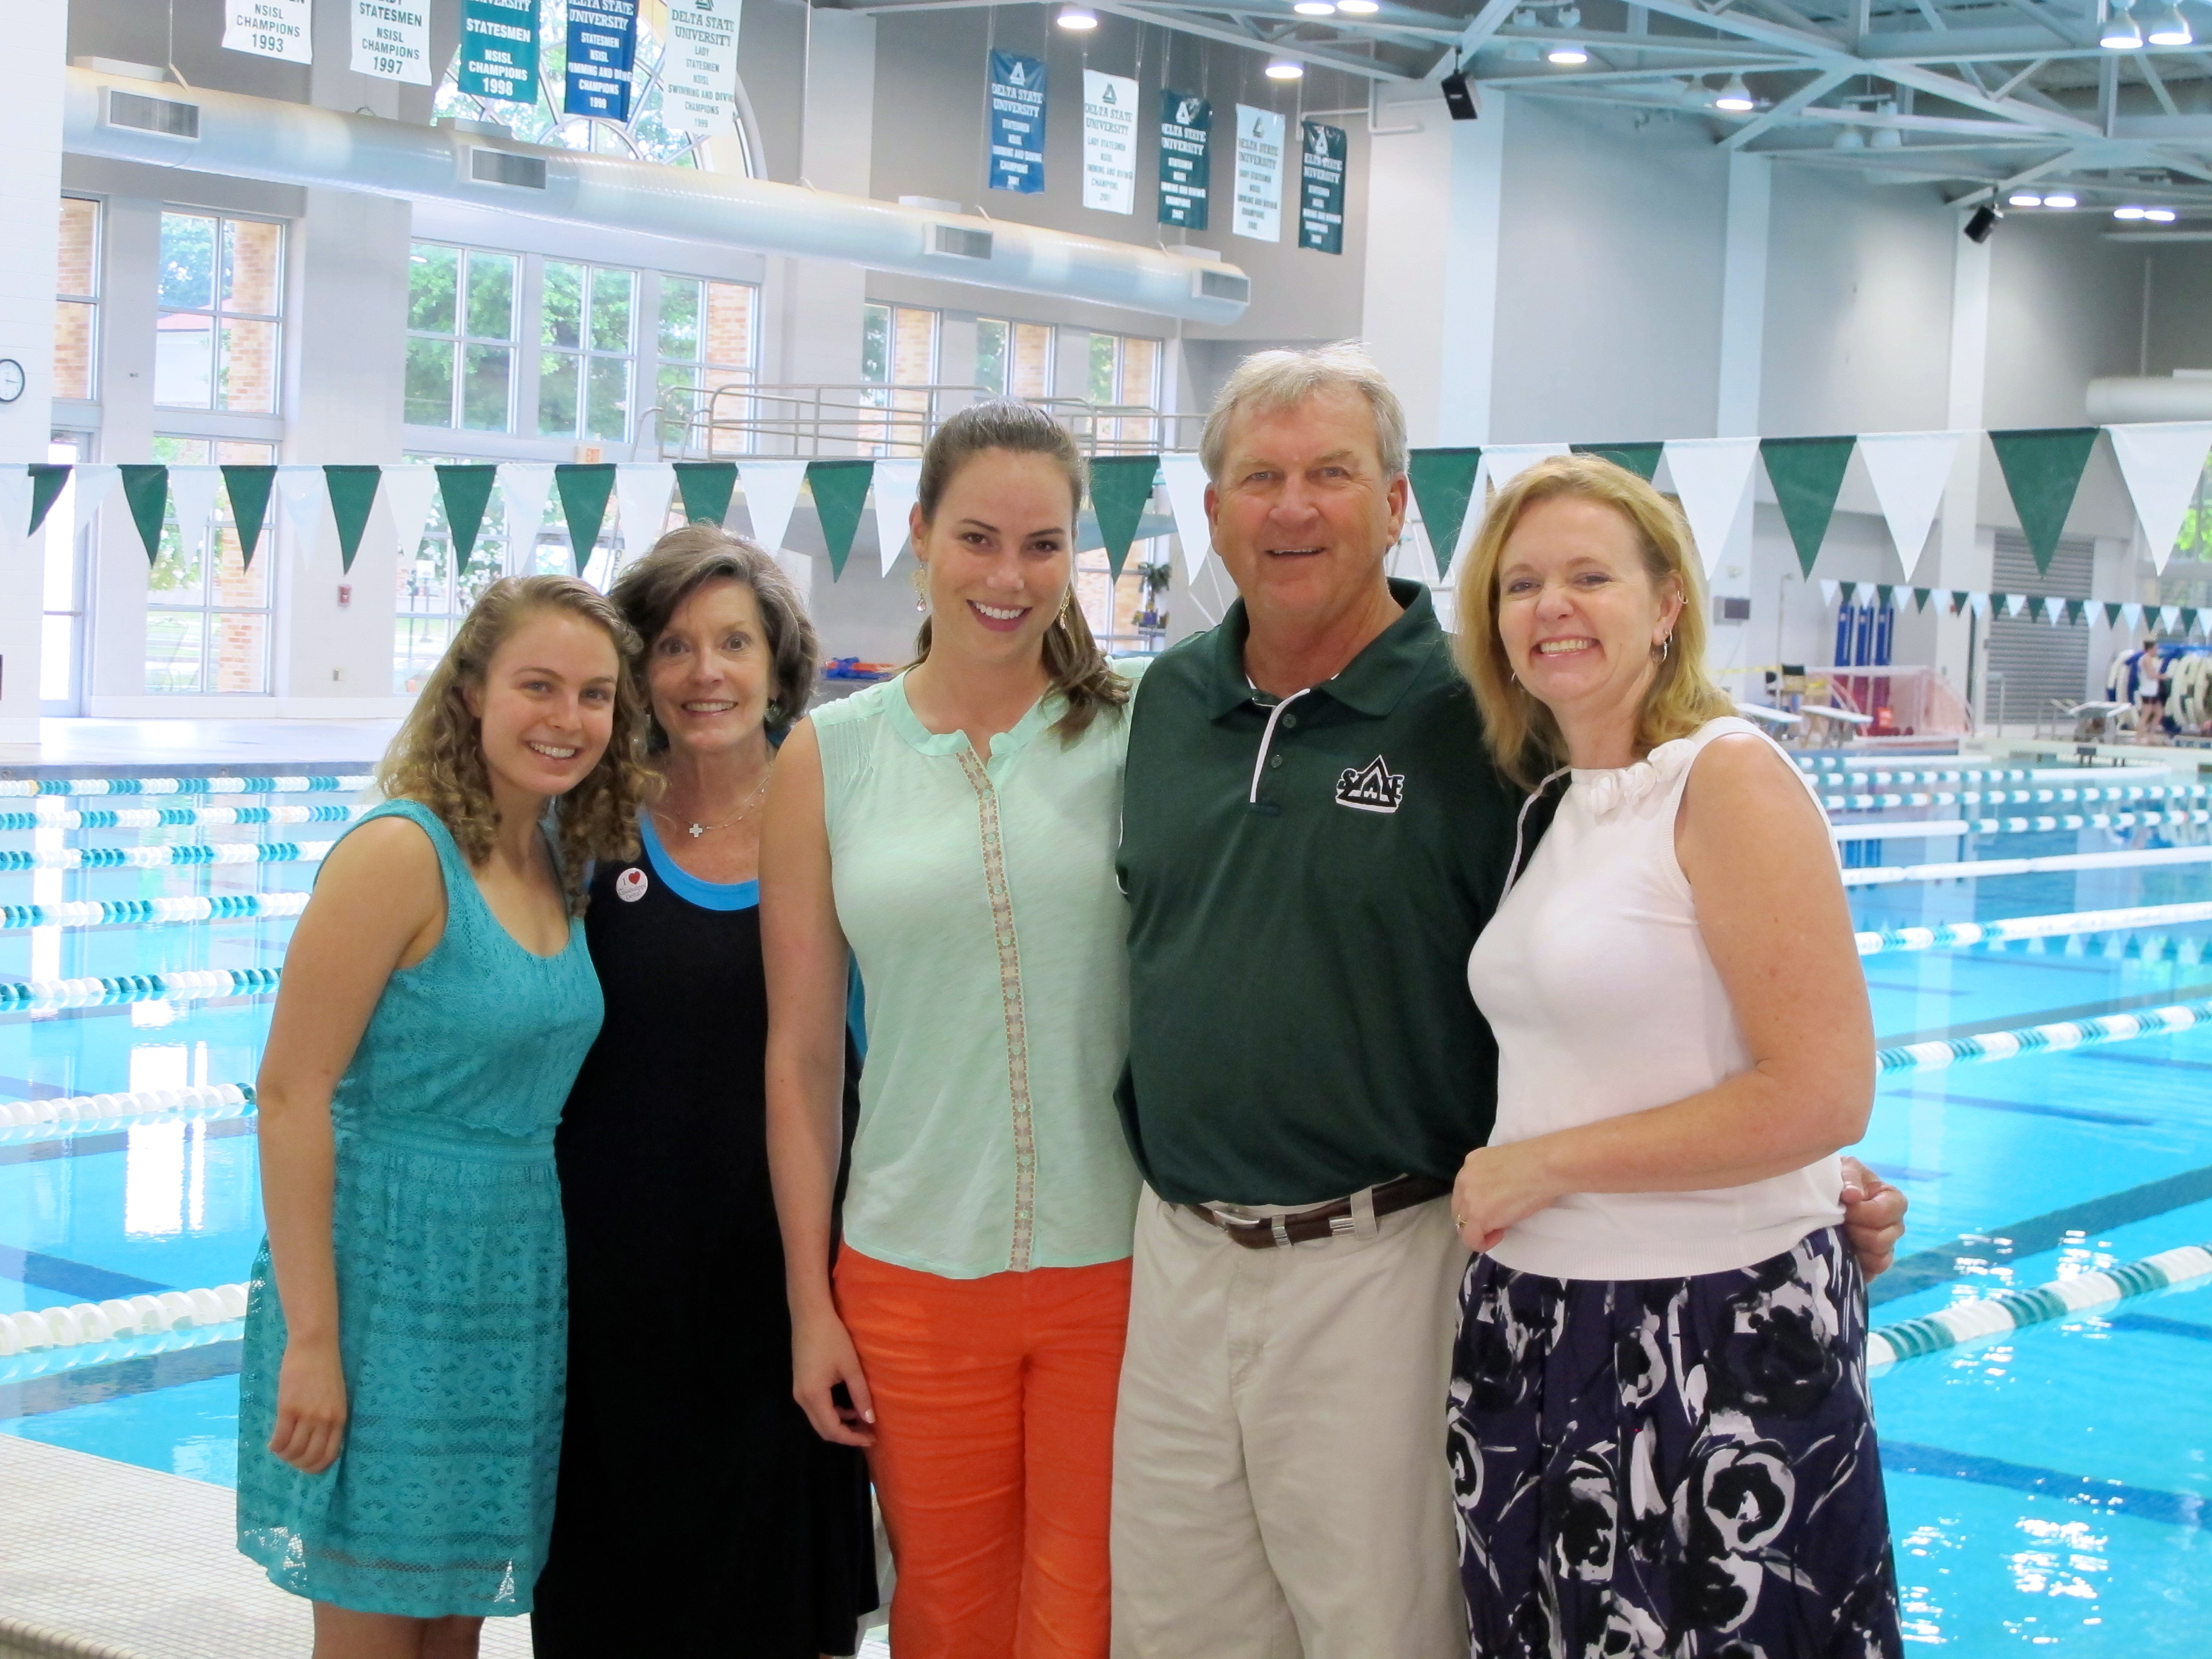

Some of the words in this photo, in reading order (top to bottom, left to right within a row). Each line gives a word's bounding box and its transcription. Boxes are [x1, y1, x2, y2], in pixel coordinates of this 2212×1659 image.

[255, 4, 284, 19] NSISL
[360, 2, 422, 27] STATESMEN
[602, 0, 634, 16] STATE
[236, 15, 300, 37] CHAMPIONS
[569, 8, 629, 30] UNIVERSITY
[671, 9, 703, 26] DELTA
[705, 16, 735, 32] STATE
[377, 27, 404, 43] NSISL
[466, 18, 531, 42] STATESMEN
[675, 25, 731, 47] UNIVERSITY
[252, 33, 284, 52] 1993
[362, 38, 420, 60] CHAMPIONS
[581, 32, 620, 49] STATESMEN
[485, 49, 513, 64] NSISL
[695, 45, 710, 57] LADY
[374, 56, 403, 75] 1997
[469, 60, 528, 81] CHAMPIONS
[598, 66, 613, 79] AND
[686, 58, 720, 73] STATESMEN
[483, 77, 514, 96] 1998
[578, 79, 619, 95] CHAMPIONS
[589, 96, 607, 109] 1999
